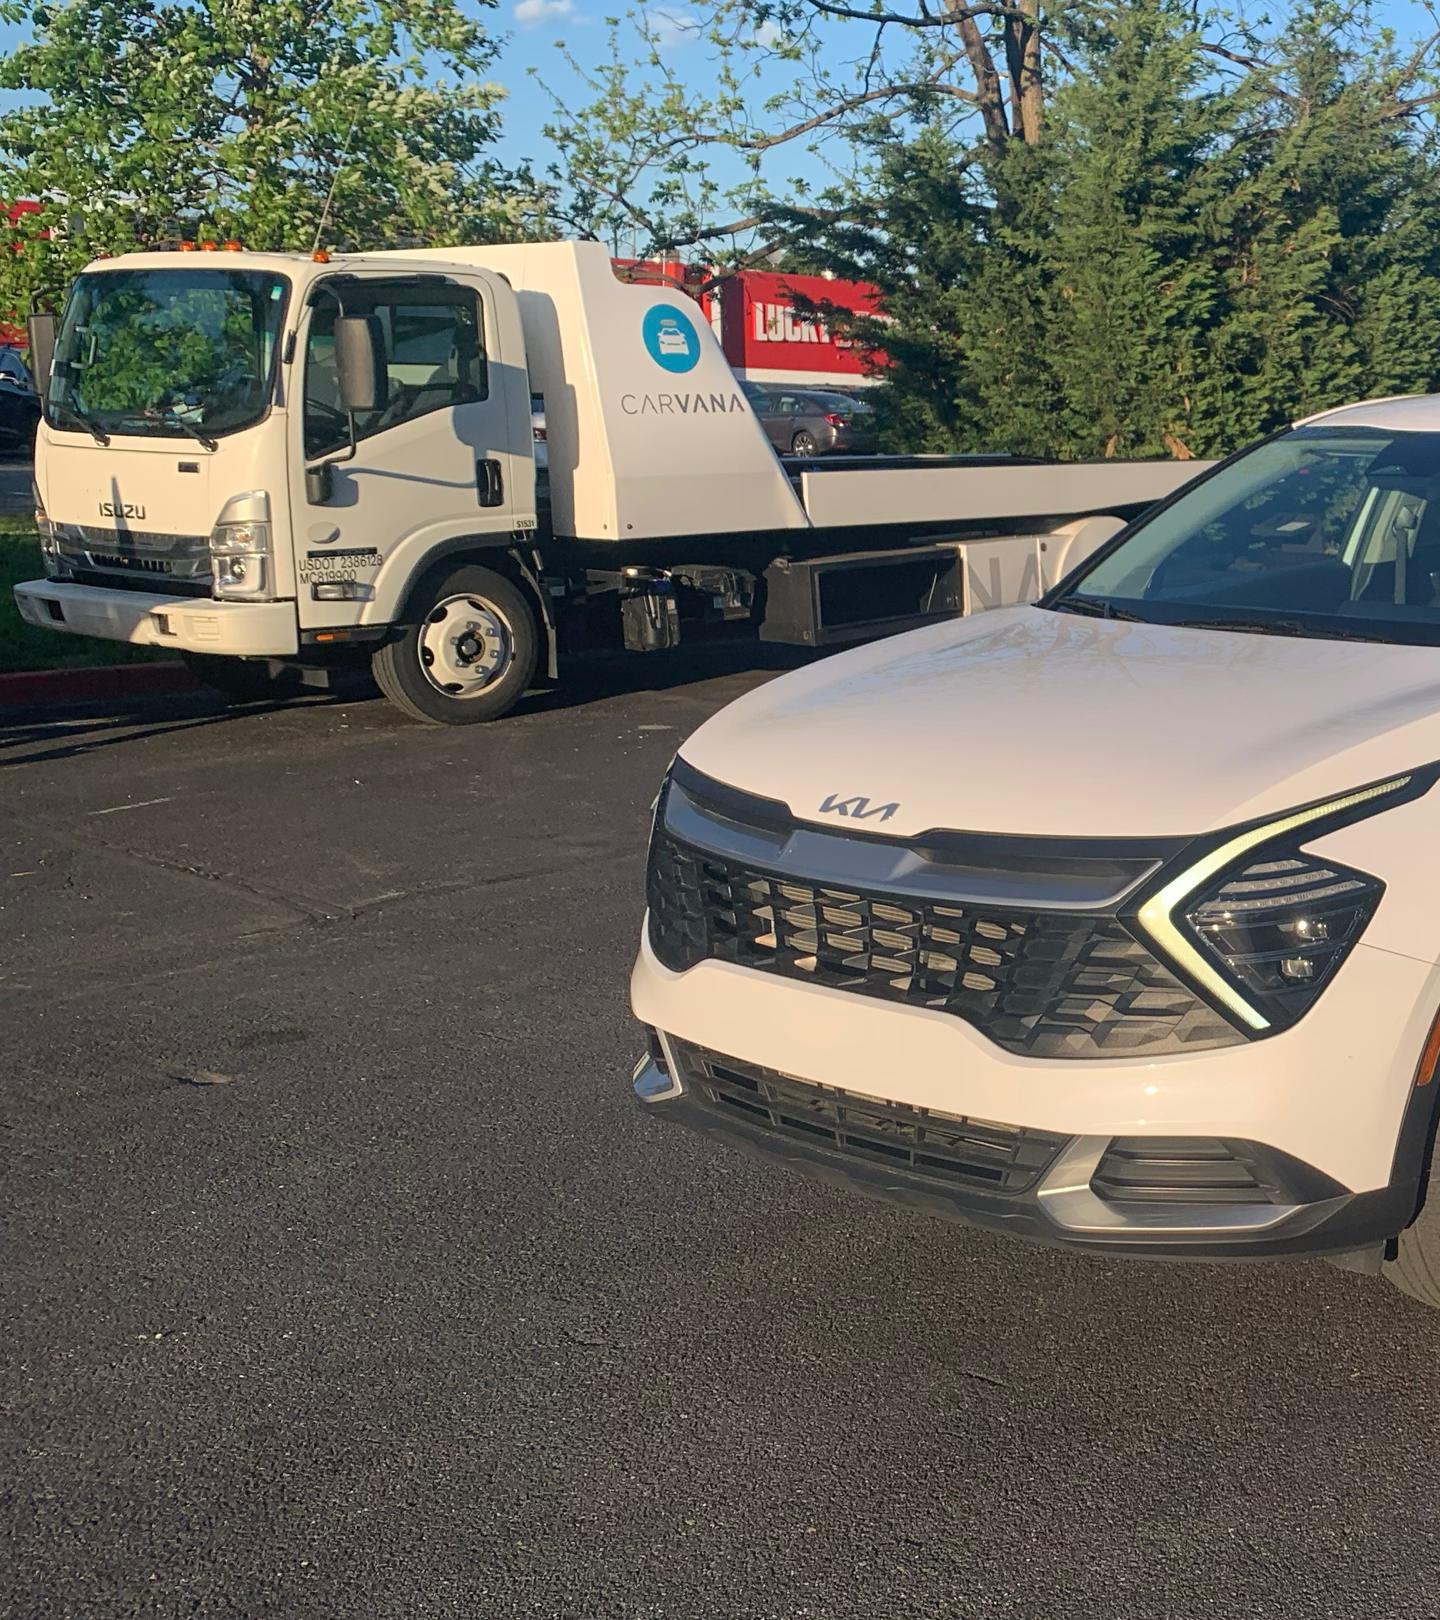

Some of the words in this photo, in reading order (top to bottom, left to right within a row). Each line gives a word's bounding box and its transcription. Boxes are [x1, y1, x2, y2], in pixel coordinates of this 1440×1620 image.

[621, 393, 745, 415] CARVANA
[99, 502, 146, 520] ISUZU
[299, 557, 336, 571] USDOT
[341, 554, 384, 569] 2386128
[300, 568, 357, 584] MC819900
